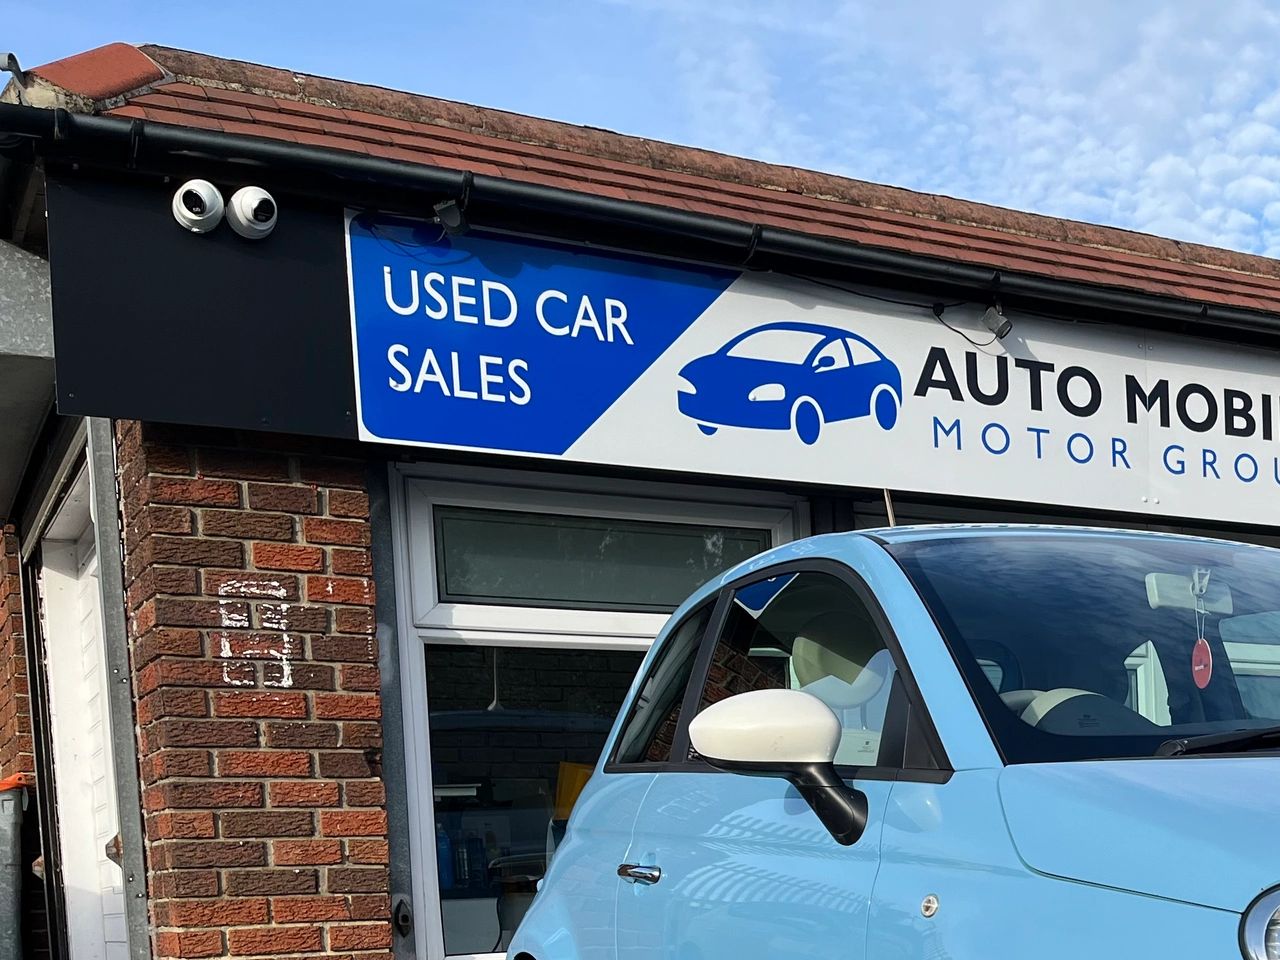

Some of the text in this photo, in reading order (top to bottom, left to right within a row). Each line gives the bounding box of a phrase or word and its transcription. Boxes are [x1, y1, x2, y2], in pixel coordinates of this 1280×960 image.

[383, 265, 635, 345] USED CAR
[387, 343, 532, 405] SALES
[913, 346, 1102, 418] AUTO
[932, 415, 1132, 470] MOTOR
